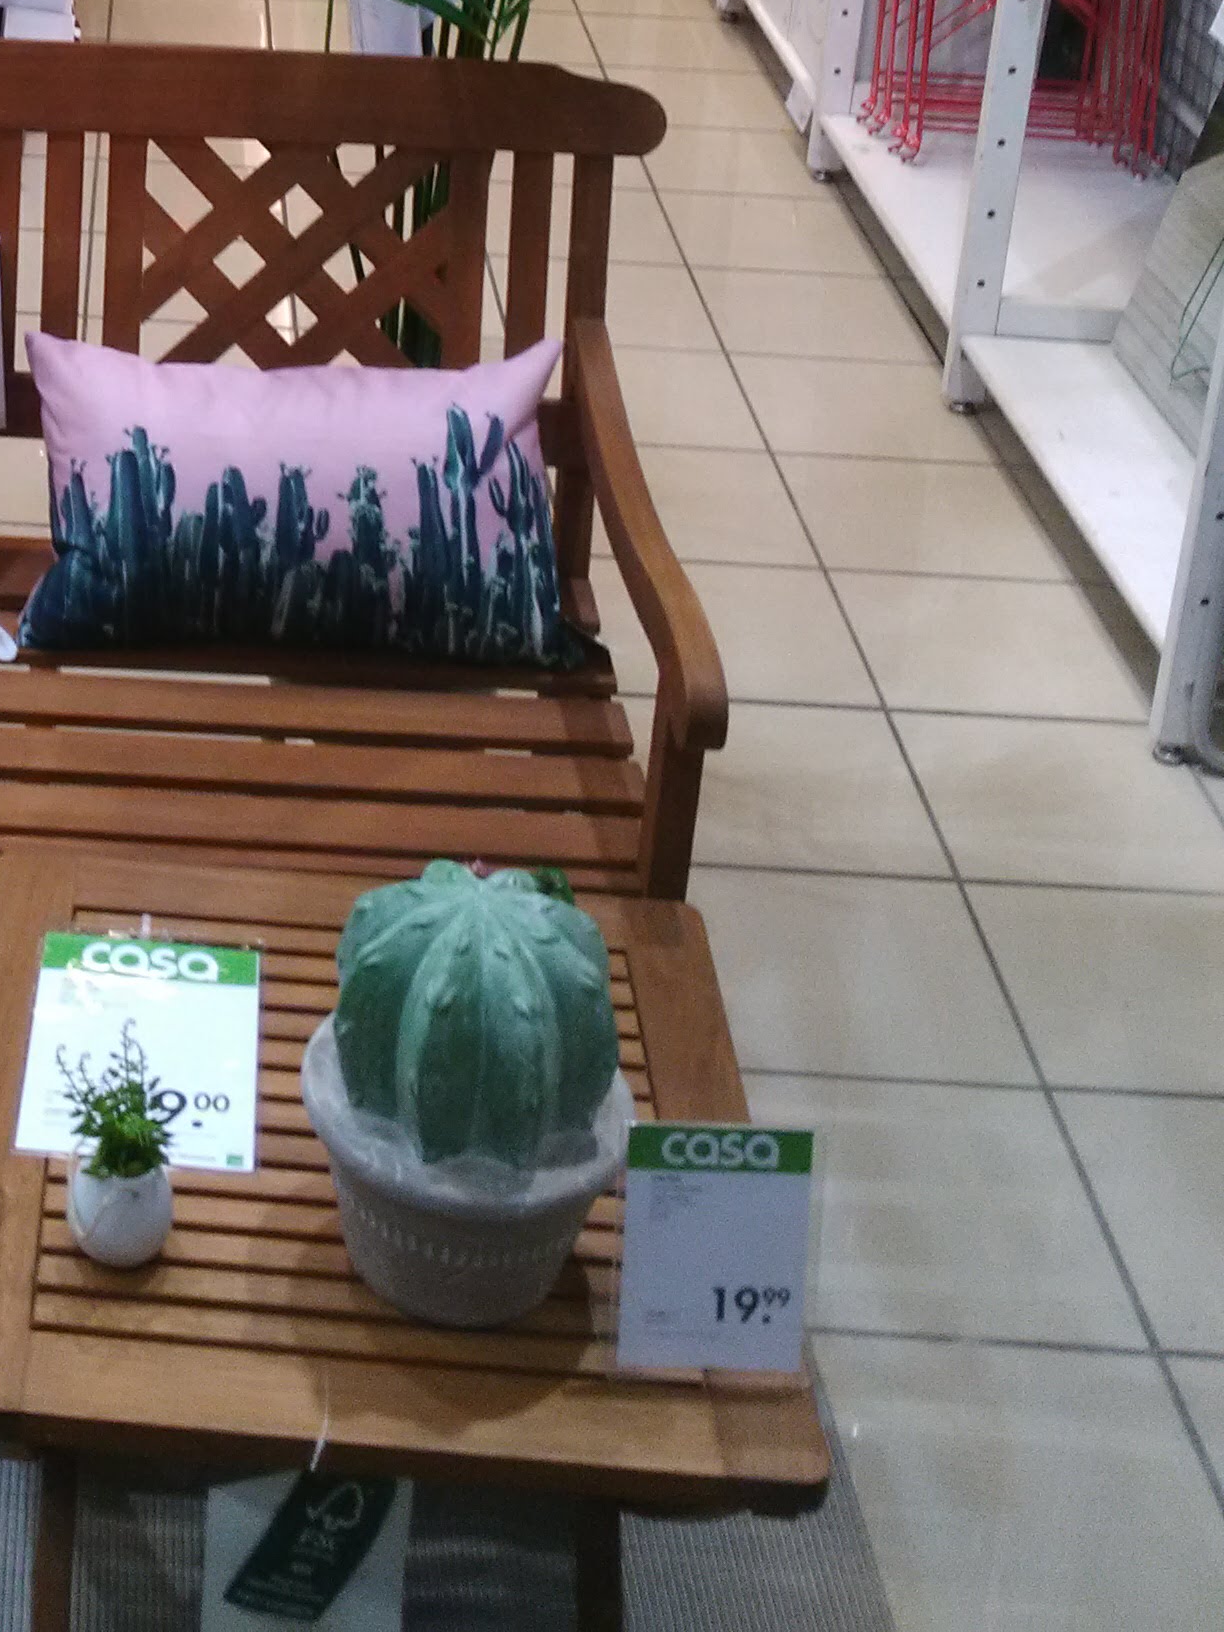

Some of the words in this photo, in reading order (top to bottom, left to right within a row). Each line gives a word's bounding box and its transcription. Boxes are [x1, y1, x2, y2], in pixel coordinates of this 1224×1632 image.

[82, 941, 220, 982] casa
[661, 1131, 780, 1168] casa
[711, 1285, 792, 1324] 19.99
